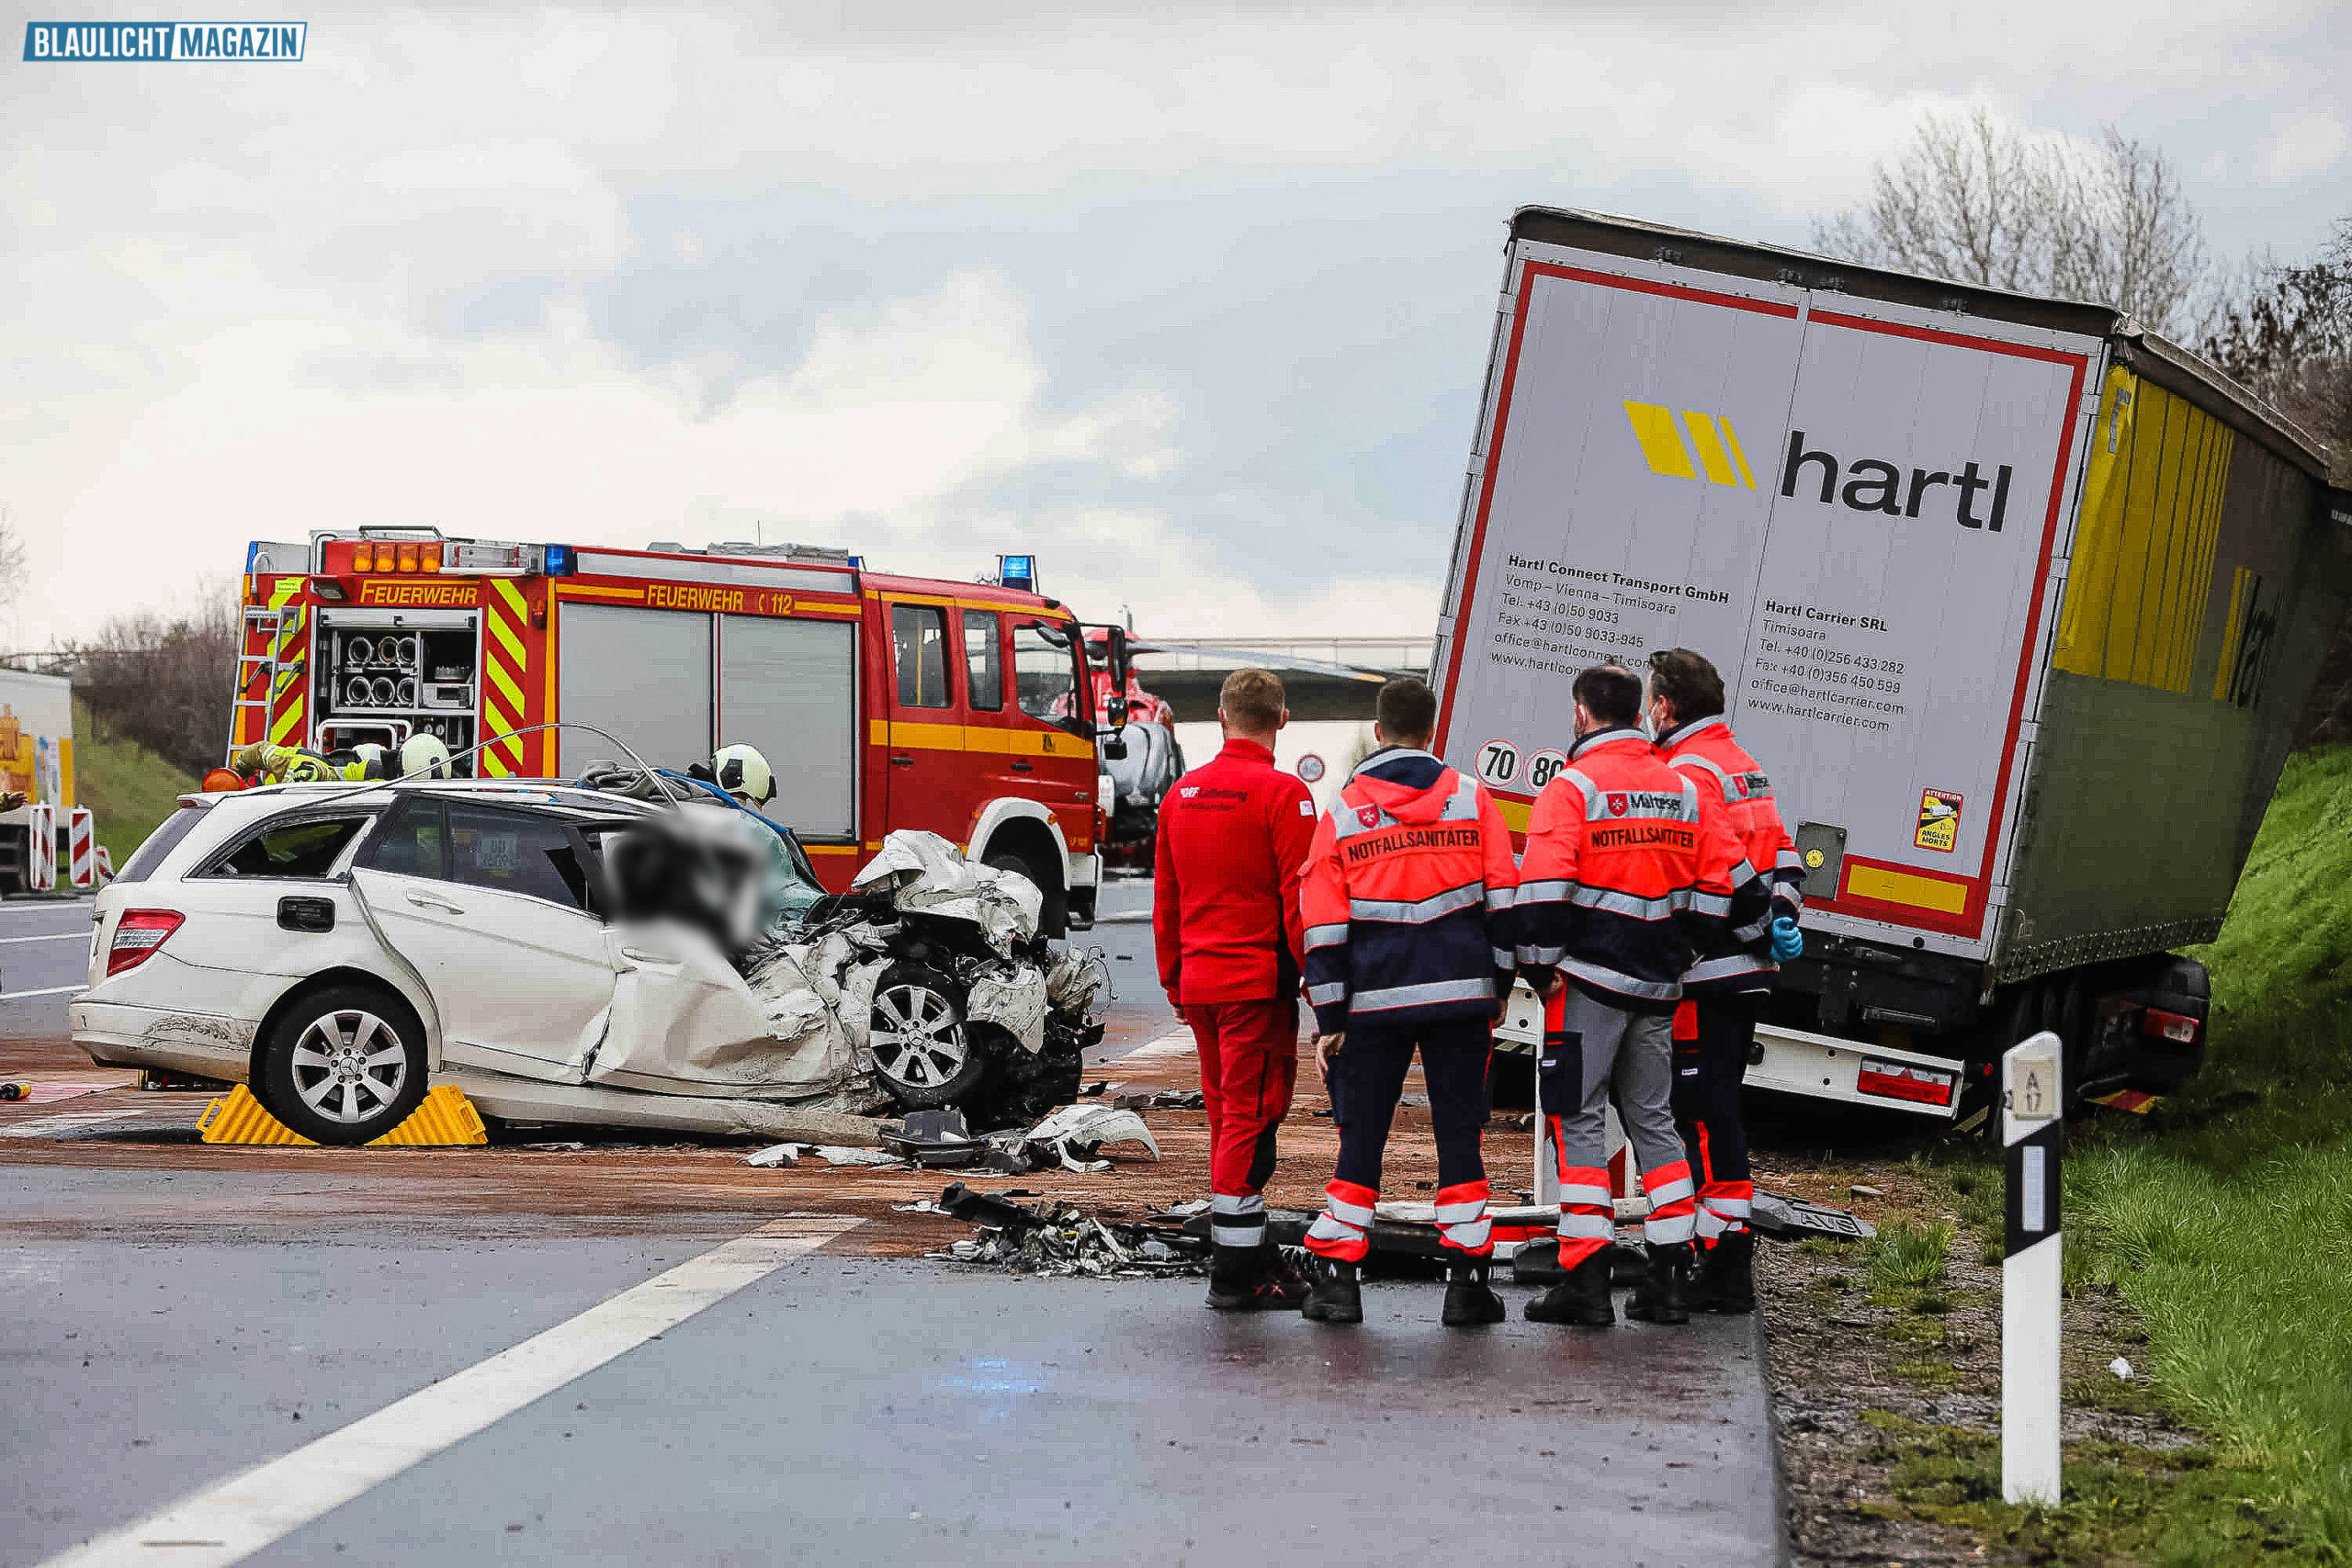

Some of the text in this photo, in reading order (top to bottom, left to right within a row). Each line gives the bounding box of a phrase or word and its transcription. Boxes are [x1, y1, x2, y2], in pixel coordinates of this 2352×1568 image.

[1781, 430, 2013, 532] hartl
[360, 580, 478, 604] FEUERWEHR
[1506, 573, 1542, 592] Vomp
[1509, 556, 1729, 604] Hartl Connect Transport GmbH
[648, 585, 792, 615] FEUERWEHR 112
[1528, 600, 1551, 612] +43
[1589, 609, 1619, 623] 9033
[1766, 601, 1888, 631] Hartl Carrier SRL
[1499, 613, 1521, 626] Fax
[1524, 618, 1547, 630] +43
[1585, 628, 1644, 648] 9033-945
[1785, 646, 1808, 658] +40
[1812, 649, 1850, 665] (0)256
[1854, 656, 1877, 670] 433
[1881, 660, 1905, 674] 282
[1781, 665, 1804, 676] +40
[1808, 667, 1847, 684] (0)356
[1850, 675, 1874, 689] 450
[1877, 680, 1901, 693] 599
[1751, 678, 1904, 715] office@hartlcarrier.com
[1747, 698, 1890, 731] www.hartlcarrier.com
[1486, 746, 1515, 779] 70
[1631, 794, 1680, 810] Malteser
[1926, 790, 1962, 801] ATTENTION
[1922, 830, 1951, 840] ANGLES
[1922, 837, 1948, 846] MORTS
[2026, 1071, 2039, 1090] A
